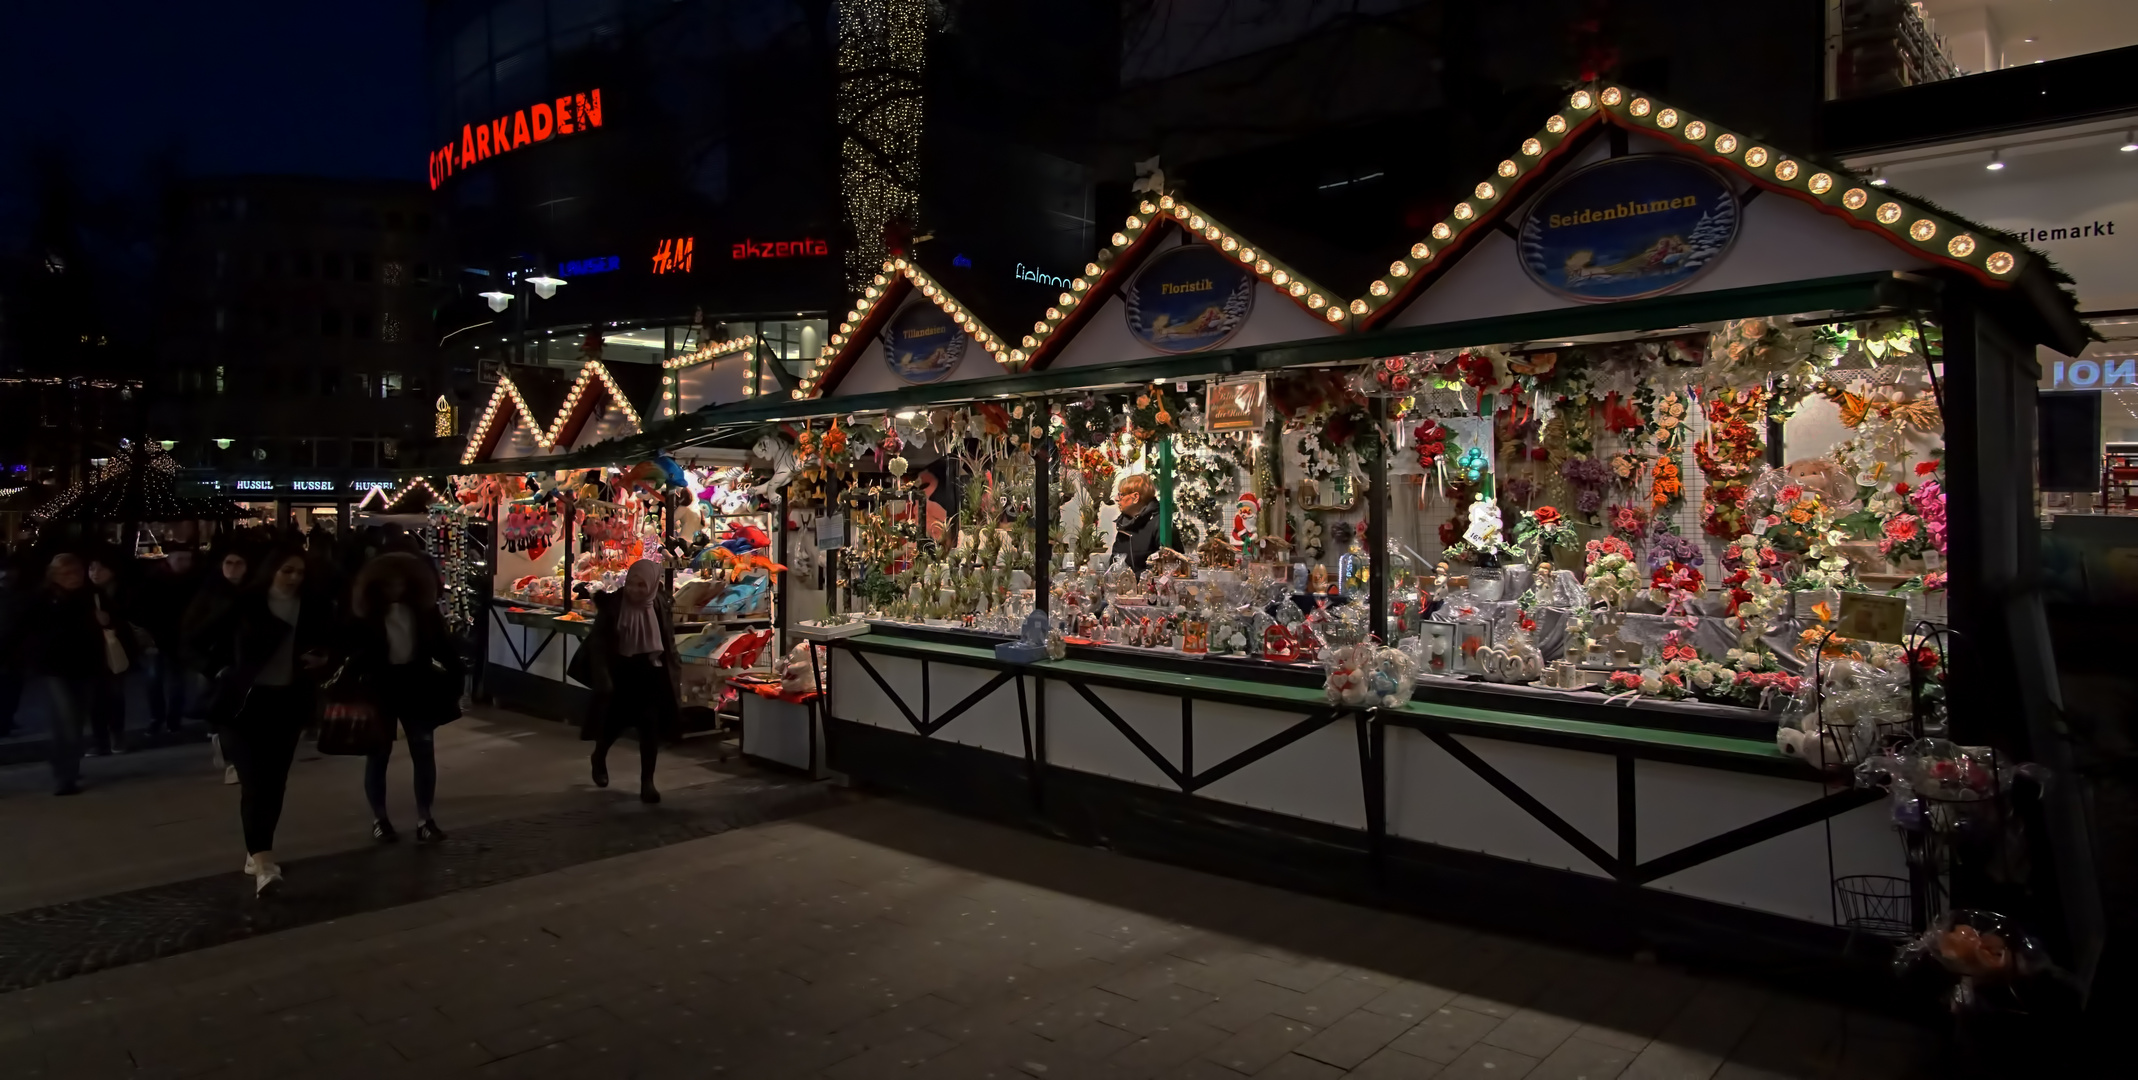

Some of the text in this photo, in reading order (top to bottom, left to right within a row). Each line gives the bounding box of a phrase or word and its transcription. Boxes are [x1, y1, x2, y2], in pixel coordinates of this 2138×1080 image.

[429, 88, 603, 191] CITY-ARKADEN
[1549, 194, 1697, 229] Seidenblumen
[652, 237, 694, 275] H&M
[732, 237, 828, 259] akzenta
[1161, 278, 1214, 295] Floristik
[236, 480, 274, 490] HUSSEL
[293, 481, 335, 491] HUSSEL
